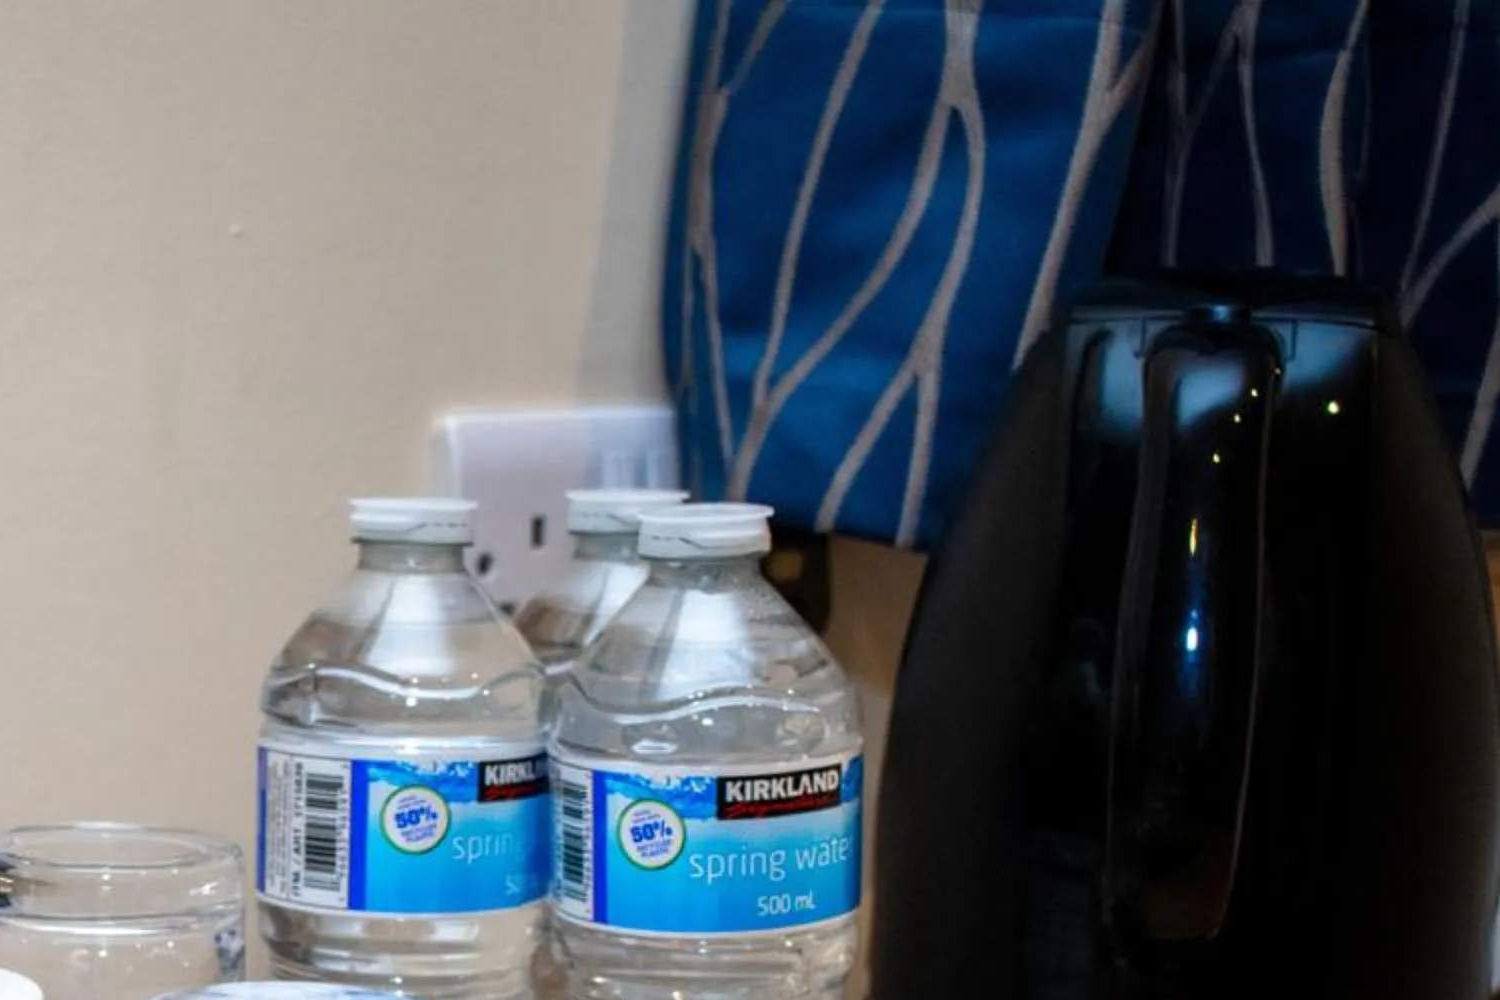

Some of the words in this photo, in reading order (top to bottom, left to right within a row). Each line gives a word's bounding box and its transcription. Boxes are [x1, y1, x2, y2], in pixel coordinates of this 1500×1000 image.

[725, 769, 840, 802] KIRKLAND
[394, 805, 439, 829] 50%
[630, 820, 673, 843] 50%
[452, 833, 519, 865] sprin
[689, 845, 787, 886] spring
[757, 893, 792, 917] 500
